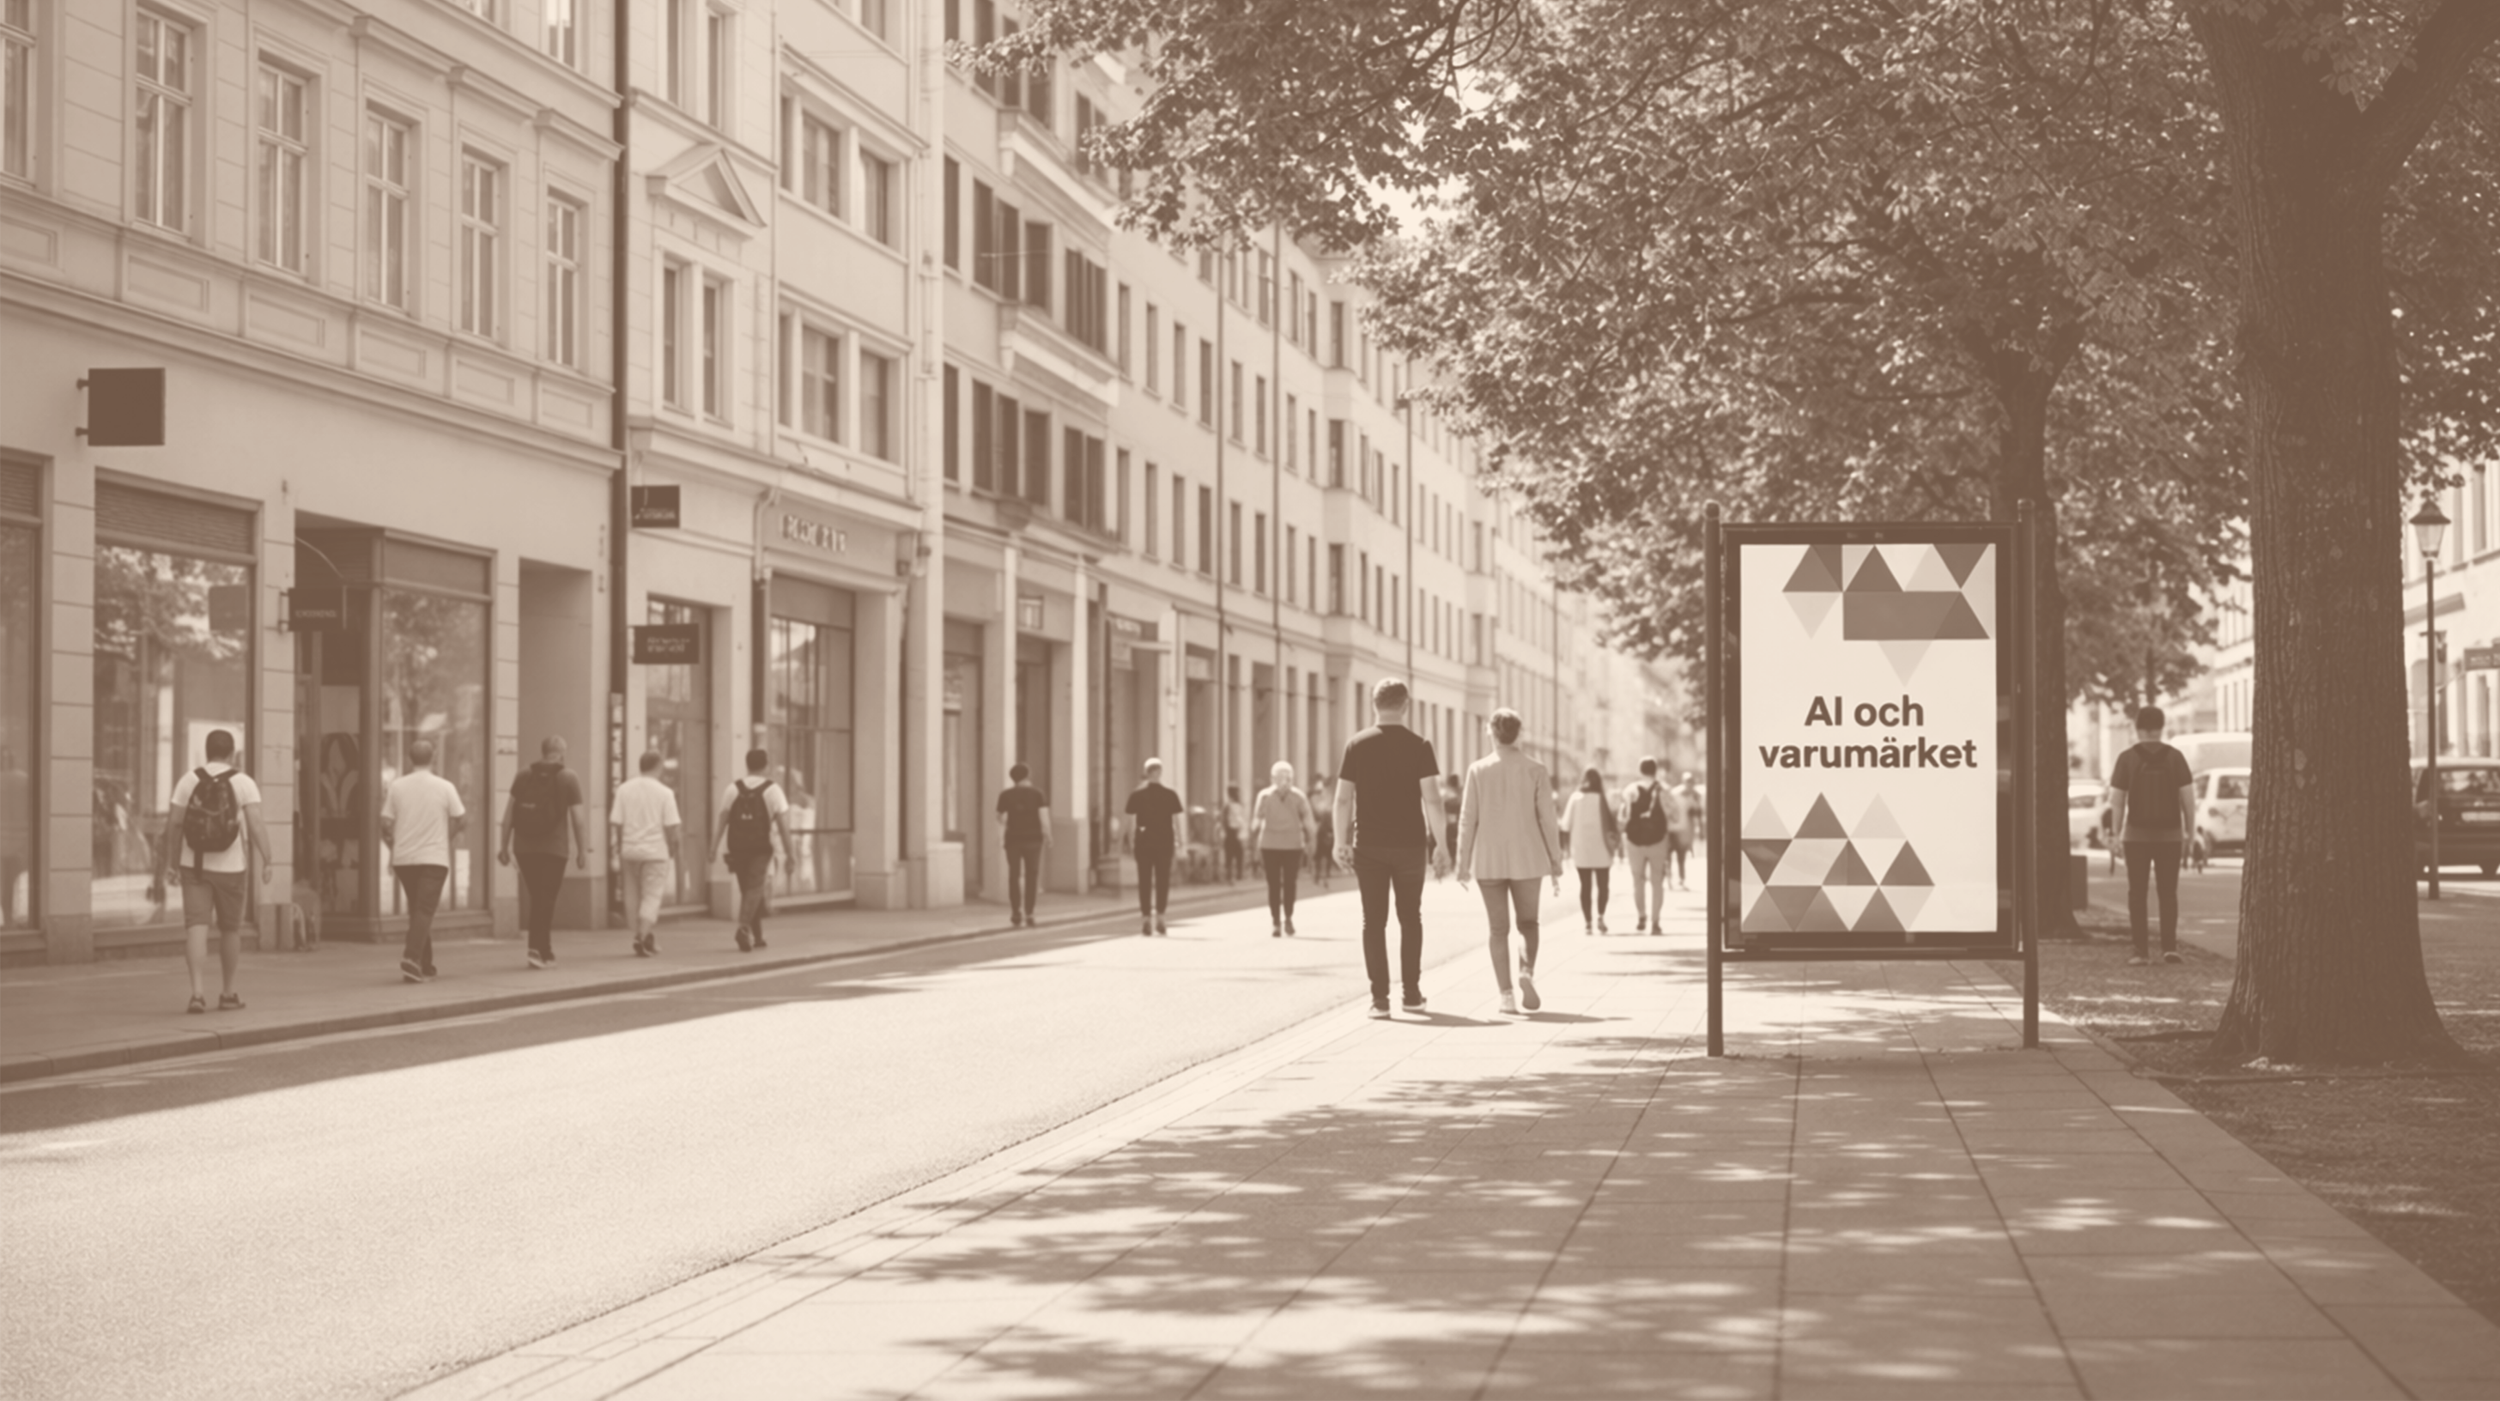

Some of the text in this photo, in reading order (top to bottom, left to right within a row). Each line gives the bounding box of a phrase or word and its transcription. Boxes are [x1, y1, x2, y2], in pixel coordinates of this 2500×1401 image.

[1804, 694, 1924, 728] AI och
[1758, 736, 1978, 769] varumärket
